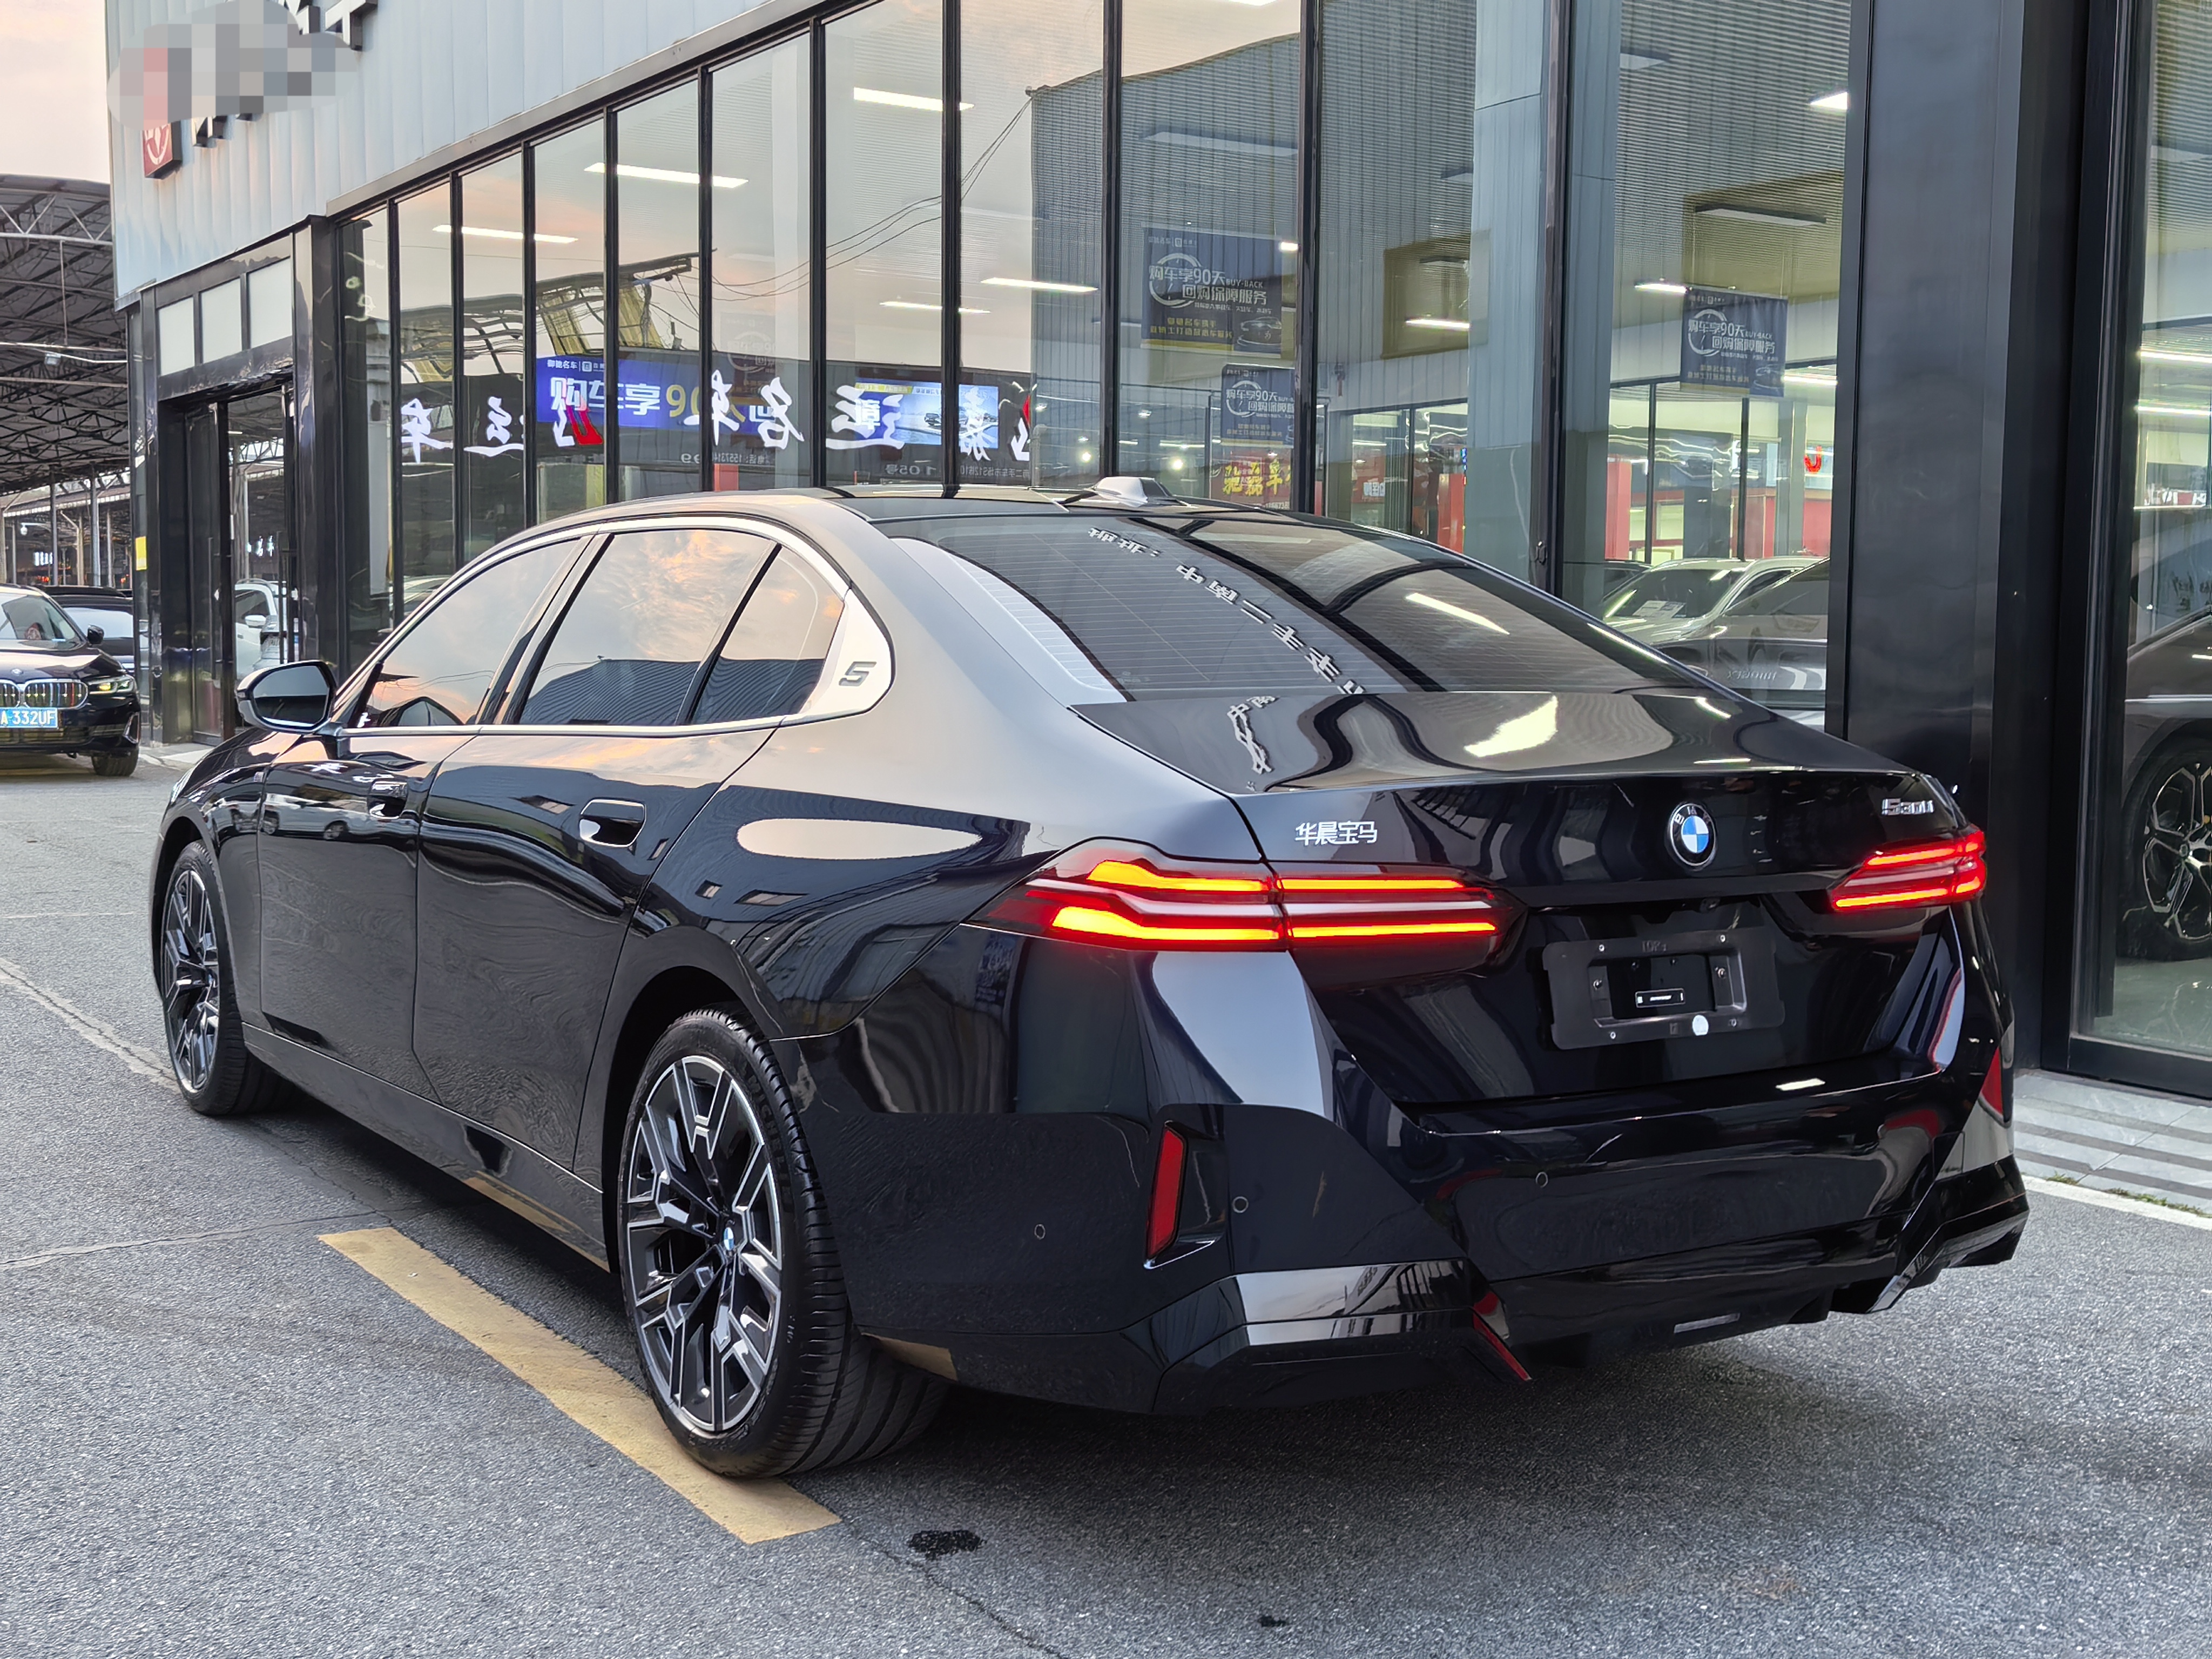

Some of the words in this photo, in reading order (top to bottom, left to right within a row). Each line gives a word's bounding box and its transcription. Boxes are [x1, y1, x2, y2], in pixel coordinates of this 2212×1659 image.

[1149, 265, 1225, 285] 购车享90天
[1182, 285, 1267, 305] 回购保障服务
[1295, 820, 1378, 846] 华晨宝马
